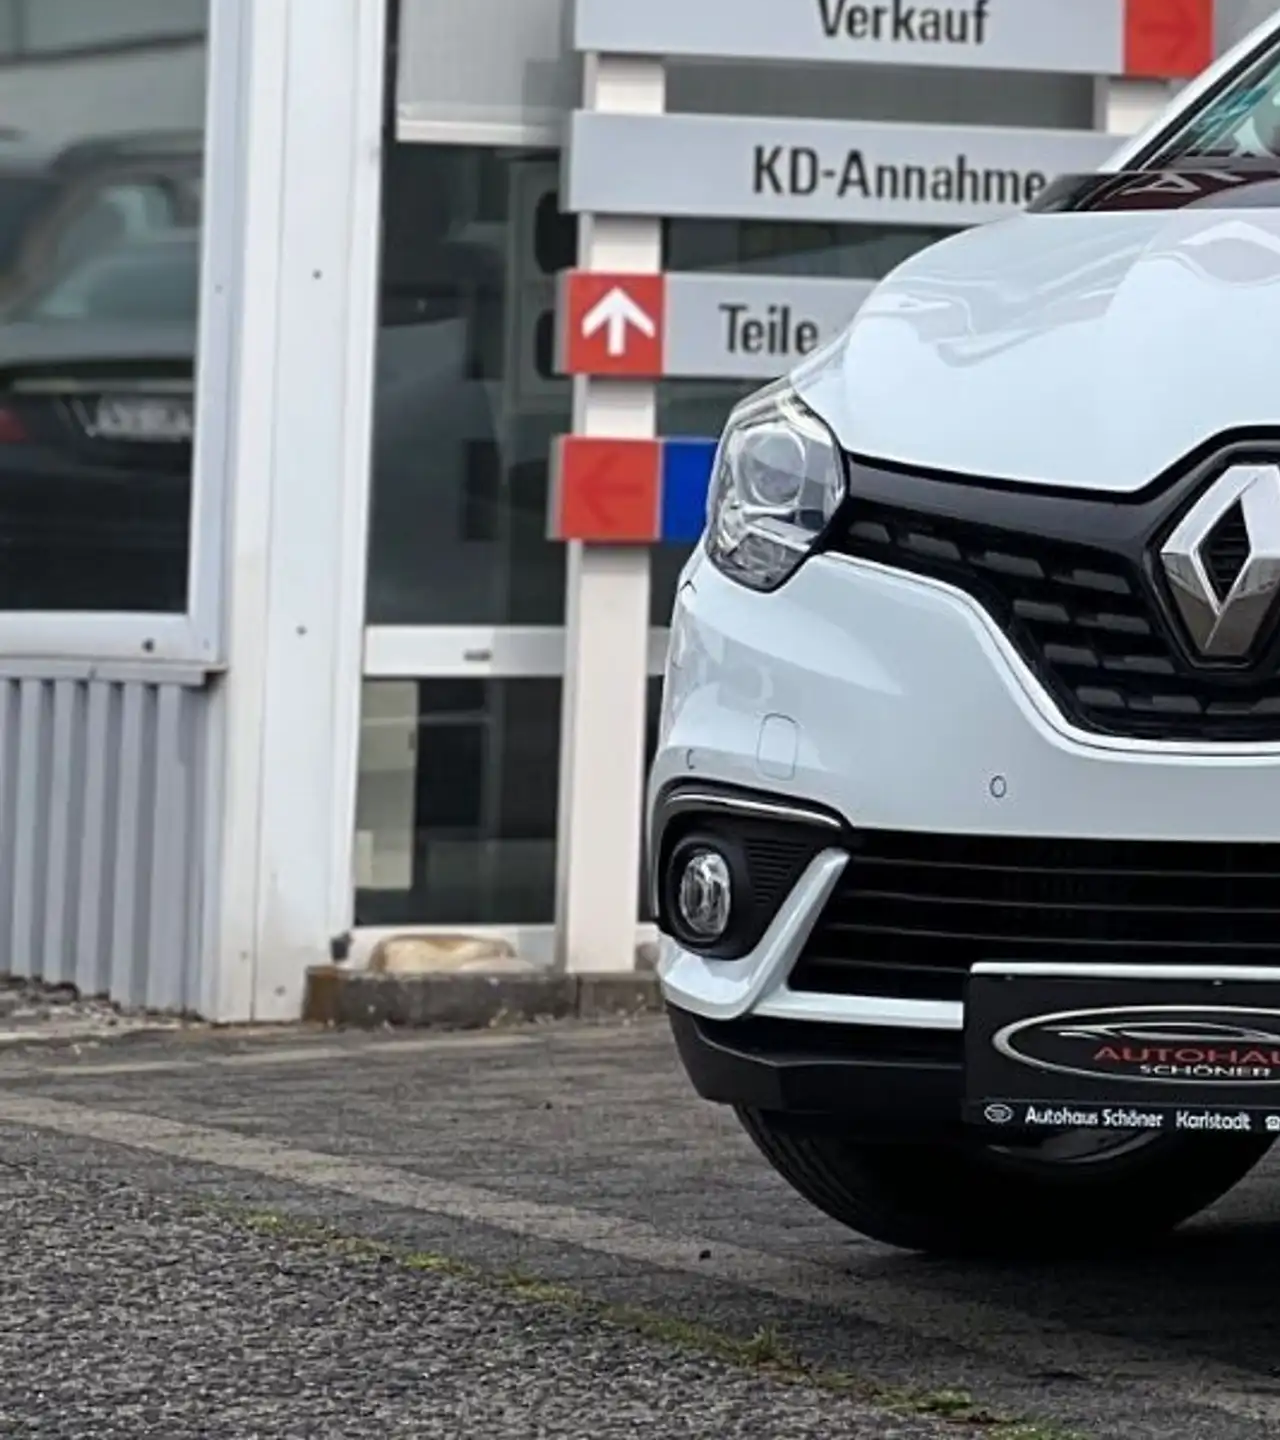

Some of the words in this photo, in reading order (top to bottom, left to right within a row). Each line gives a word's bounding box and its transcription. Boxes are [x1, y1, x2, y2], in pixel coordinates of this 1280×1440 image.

[751, 143, 1047, 205] KD-Annahme
[718, 303, 818, 356] Teile
[1139, 1062, 1272, 1078] SCHÖNER
[1024, 1105, 1098, 1125] Autohaus
[1101, 1106, 1164, 1128] Schöner
[1175, 1110, 1251, 1131] Karlstadt
